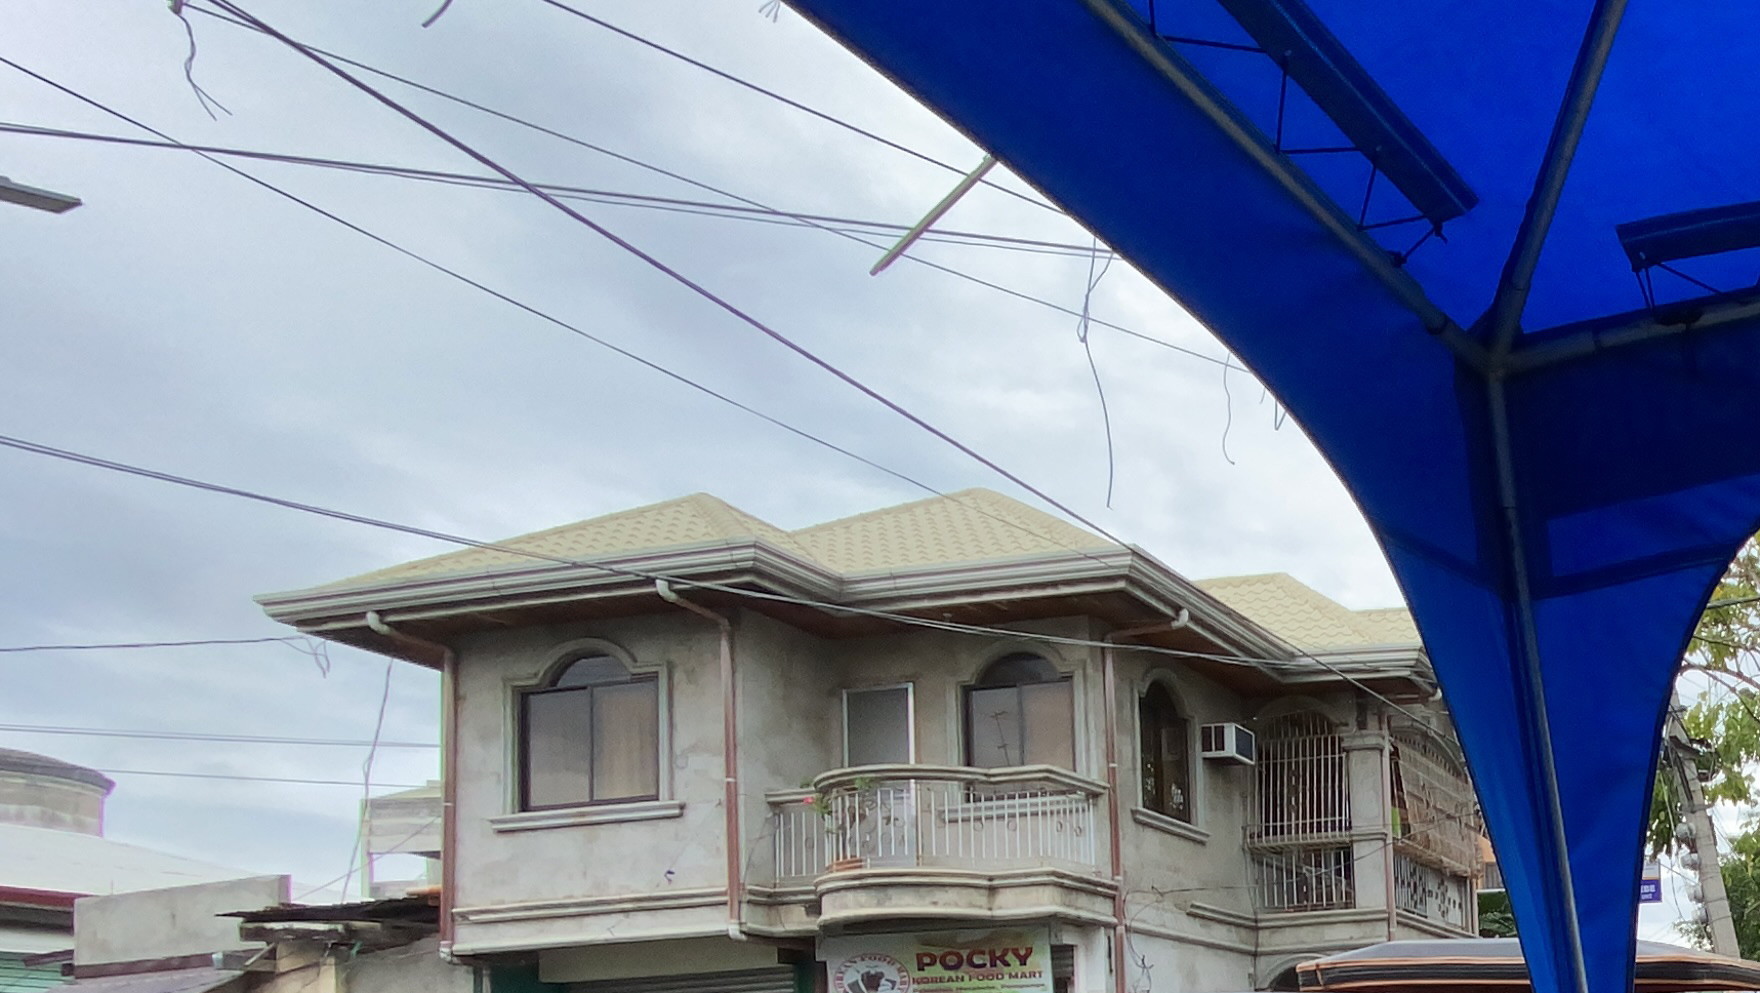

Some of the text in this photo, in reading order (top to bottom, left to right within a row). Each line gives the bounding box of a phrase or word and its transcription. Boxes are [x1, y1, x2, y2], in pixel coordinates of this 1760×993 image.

[916, 947, 1033, 971] POCKY
[912, 970, 1043, 985] KOREAN FOOD MART
